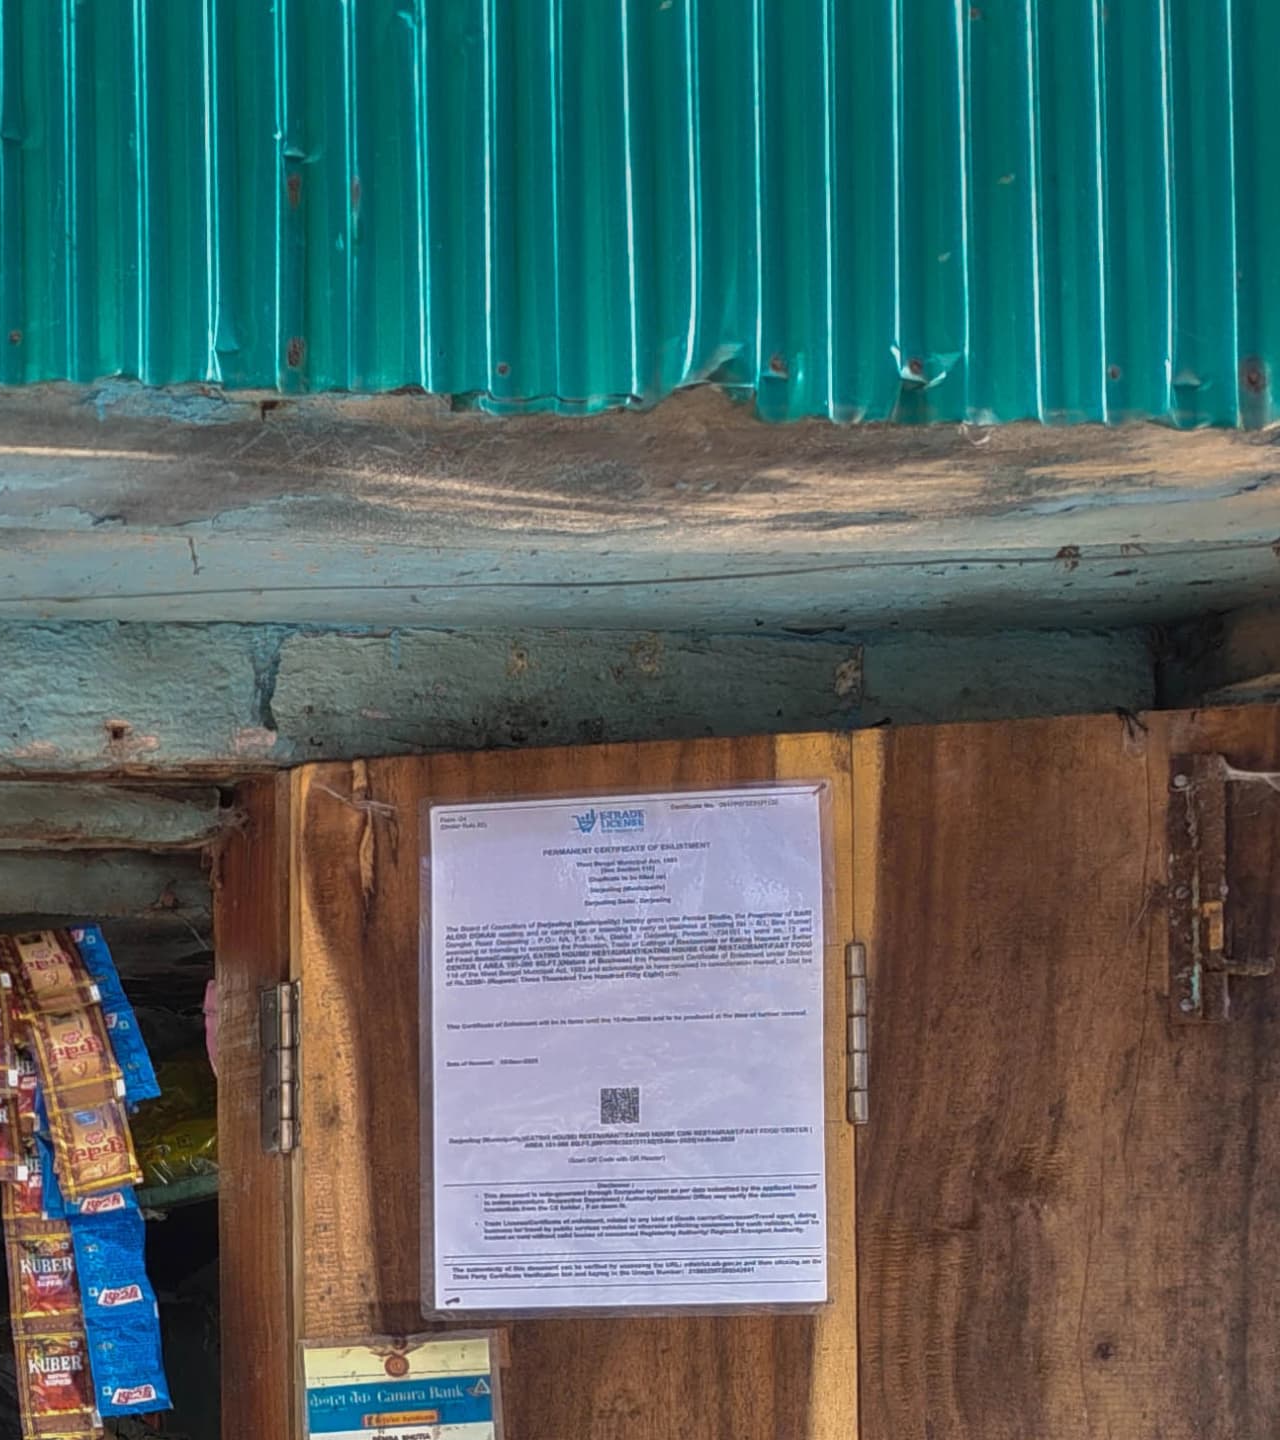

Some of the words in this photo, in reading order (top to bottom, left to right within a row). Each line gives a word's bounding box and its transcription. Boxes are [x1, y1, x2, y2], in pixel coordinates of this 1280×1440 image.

[21, 1256, 73, 1275] KUBER
[28, 1355, 83, 1375] KUBER
[377, 1388, 425, 1403] Canara
[429, 1384, 464, 1399] Bank
